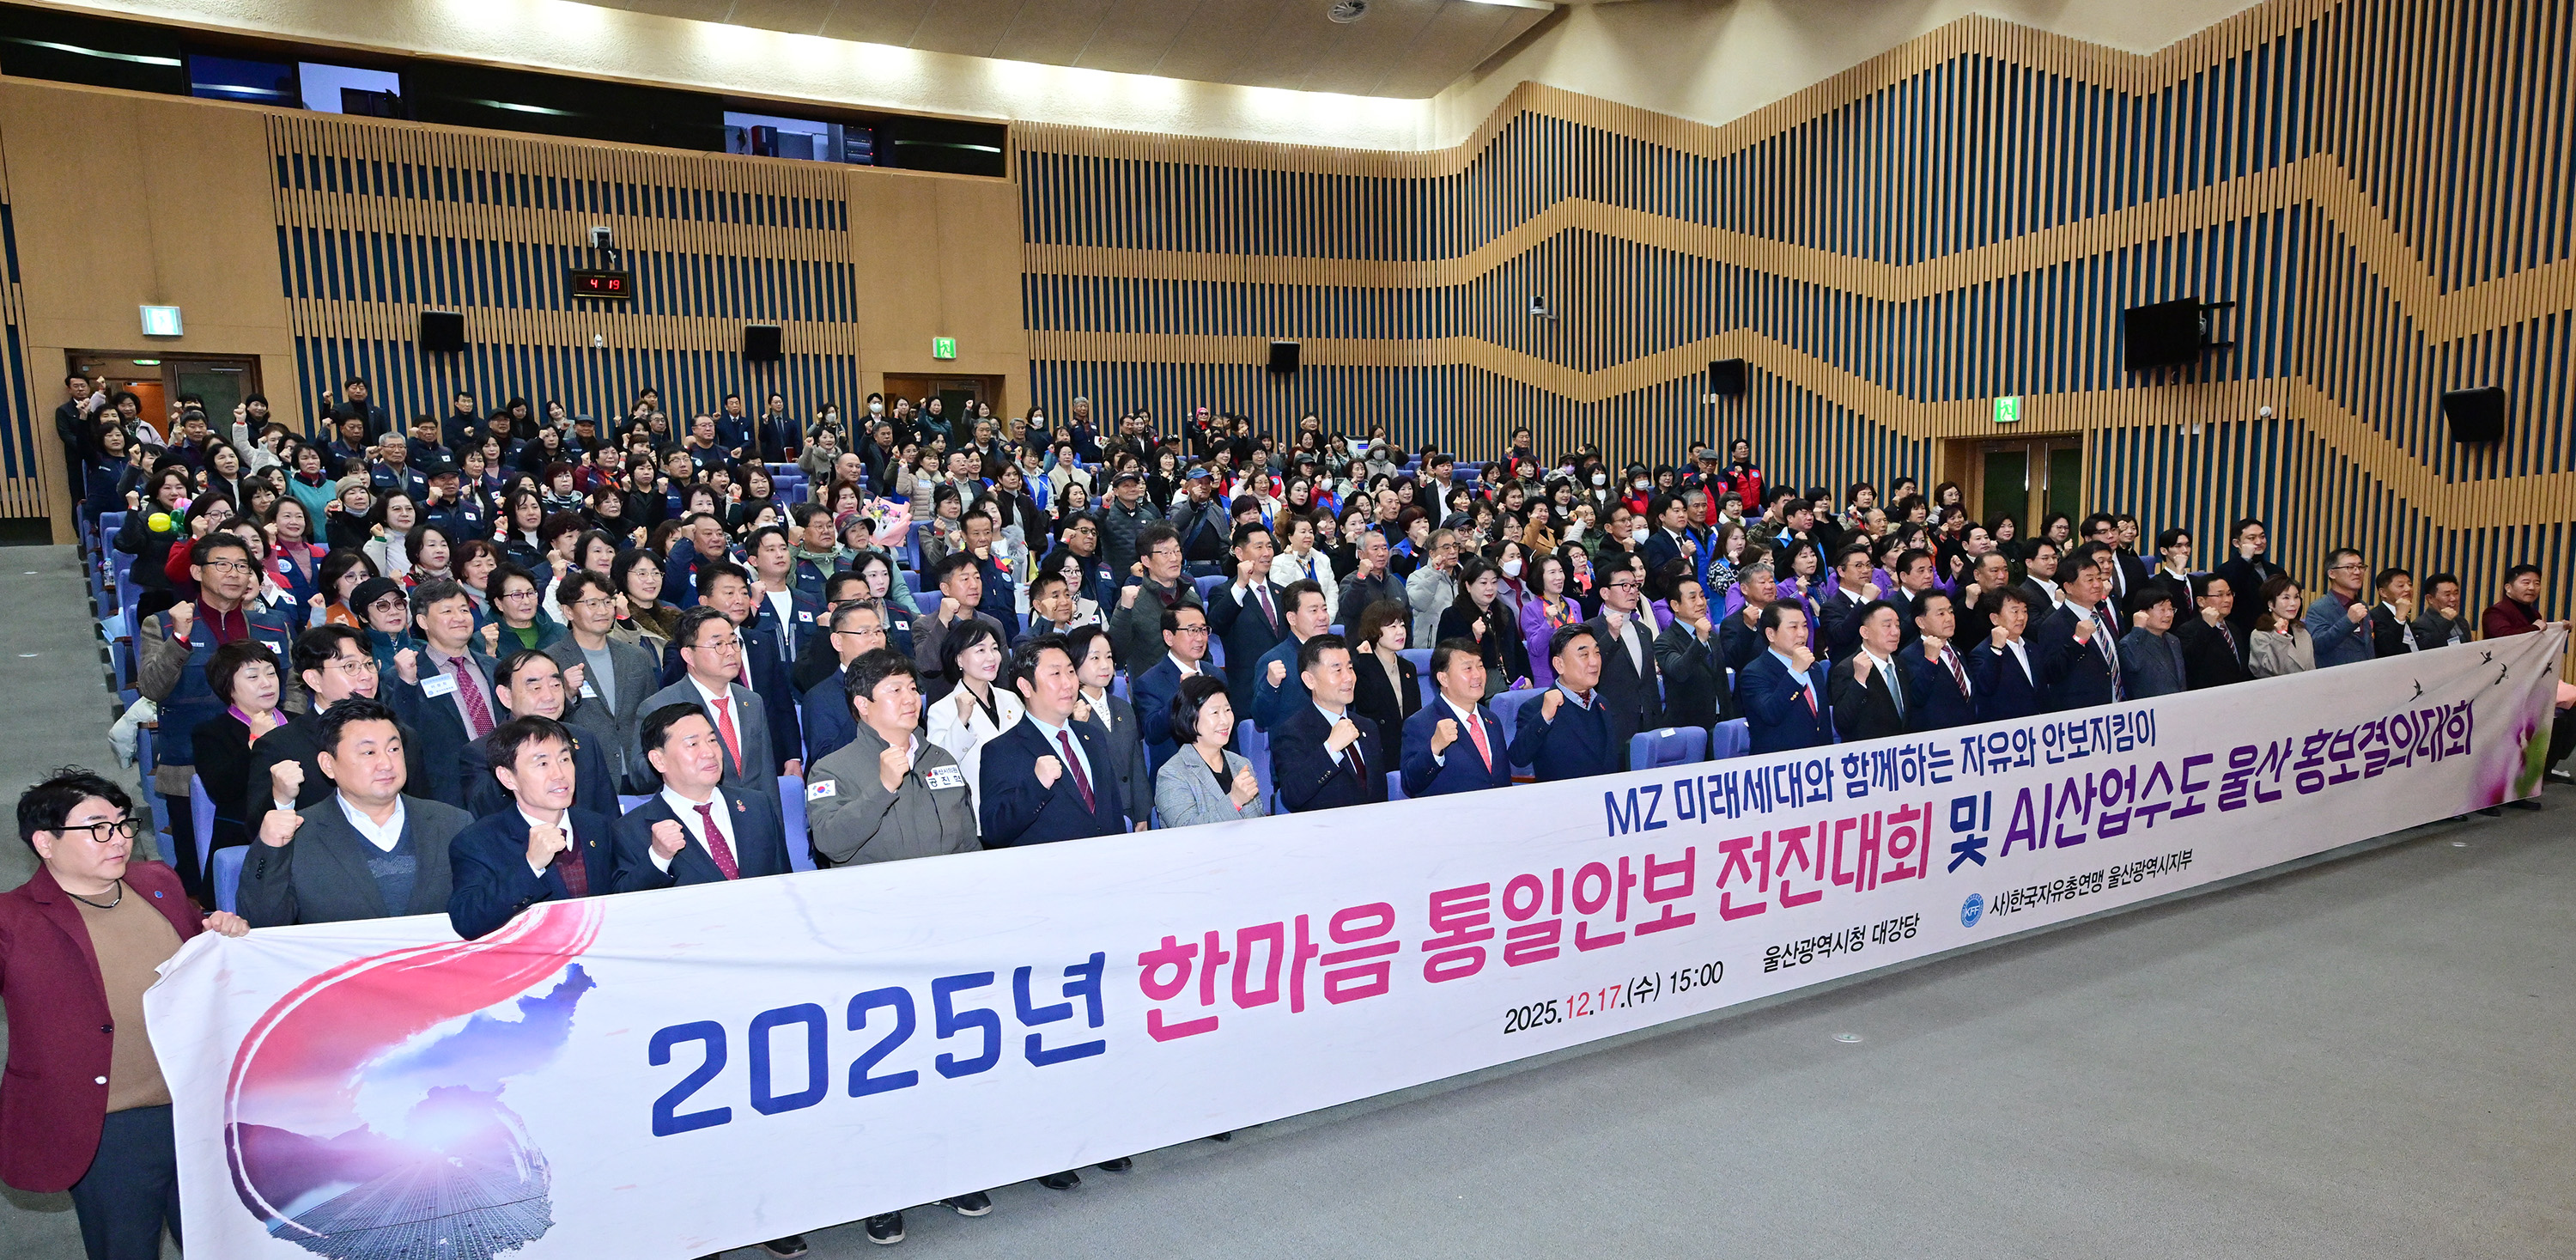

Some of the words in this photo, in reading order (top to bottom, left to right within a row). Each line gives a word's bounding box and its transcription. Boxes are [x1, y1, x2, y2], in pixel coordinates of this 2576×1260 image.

[608, 279, 620, 290] 19
[1604, 783, 1668, 837] MZ
[1674, 757, 1834, 825] 미래세대와
[1841, 742, 1954, 799] 함께하는
[1960, 726, 2037, 776] 자유와
[2042, 709, 2156, 764] 안보지킴이
[1964, 905, 1980, 917] KFF
[1990, 869, 2104, 917] 사)한국자유총연맹
[2107, 848, 2194, 892] 울산광역시지부
[648, 951, 1106, 1137] 2025년
[1137, 902, 1400, 1043] 한마음
[1422, 846, 1696, 983] 통일안보
[1716, 801, 1933, 922] 전진대회
[1947, 790, 1992, 873] 및
[2000, 752, 2214, 857] AI산업수도
[2218, 736, 2293, 813] 울산
[2293, 699, 2475, 795] 홍보결의대회
[1763, 922, 1866, 973] 울산광역시청
[1871, 912, 1920, 945] 대강당
[1504, 971, 1661, 1034] 2025.12.17.(수)
[1670, 960, 1724, 995] 15:00
